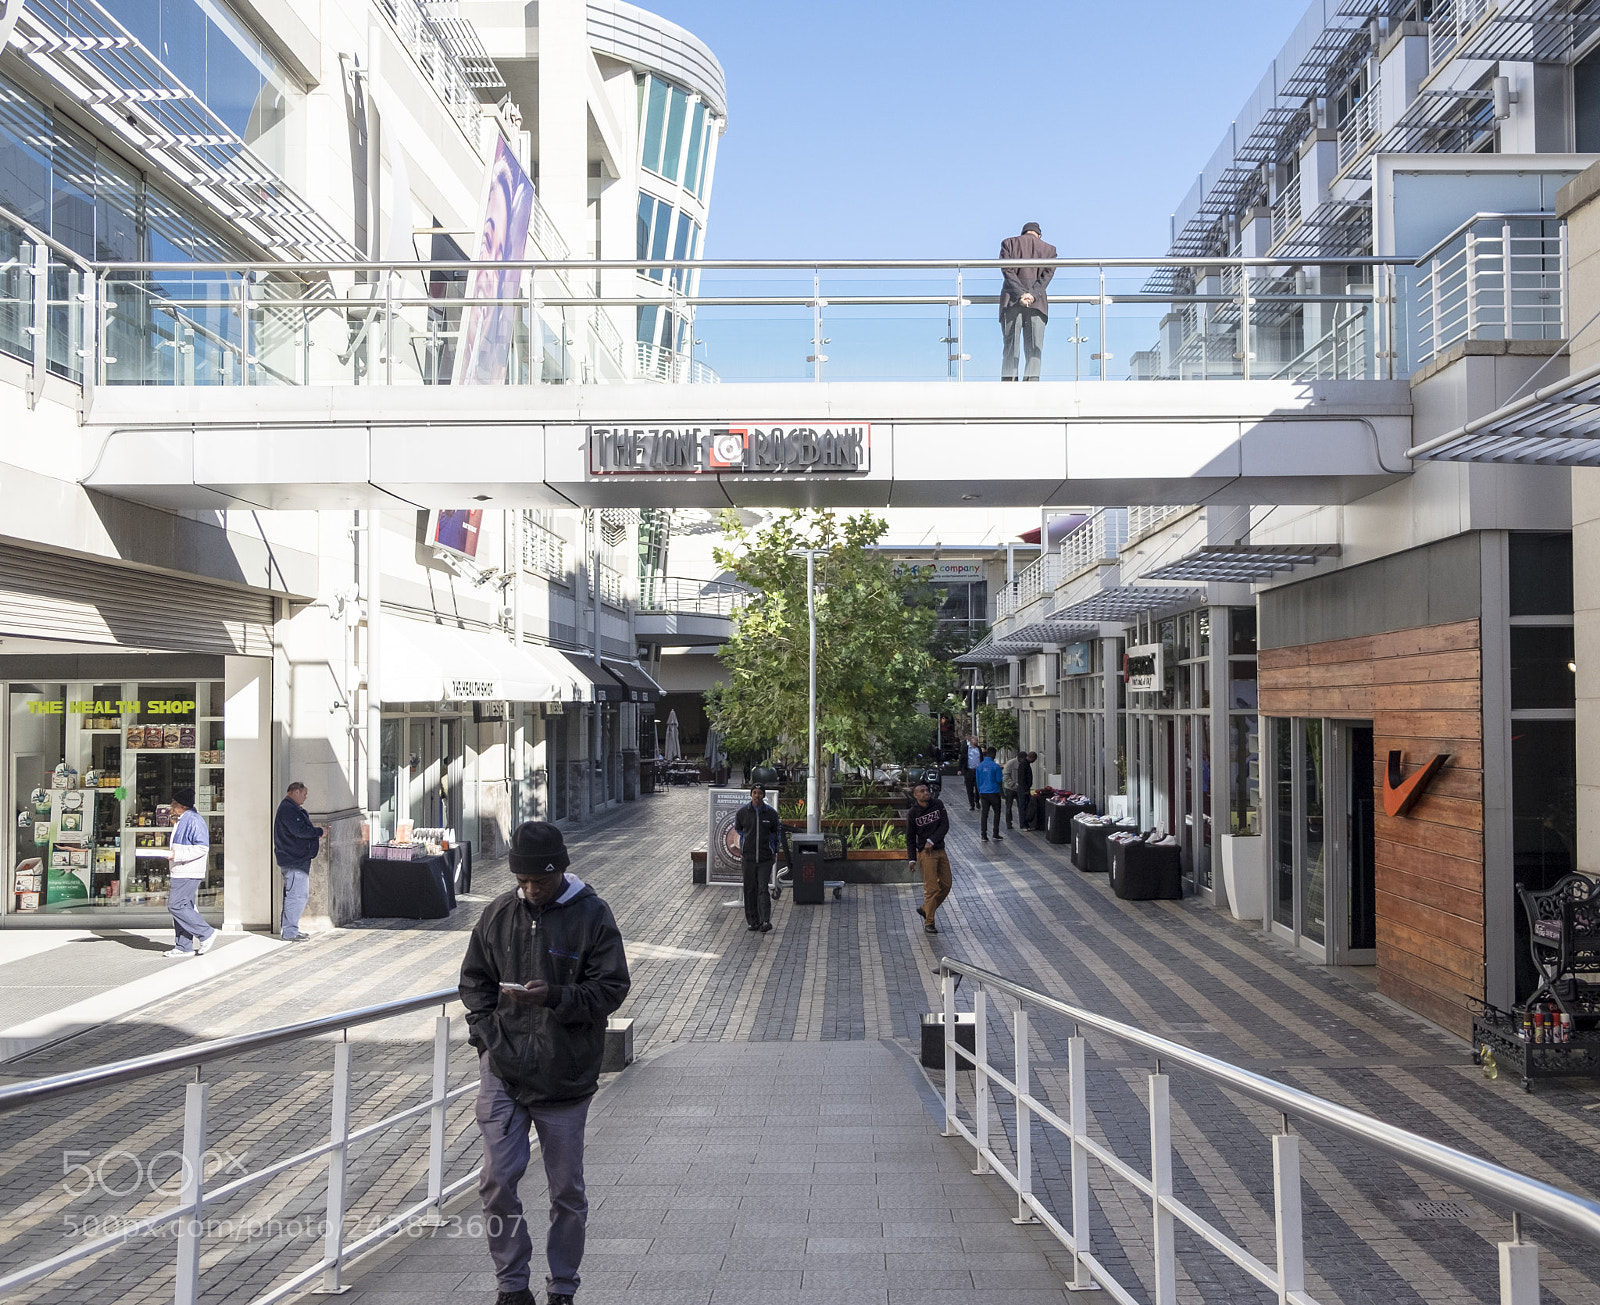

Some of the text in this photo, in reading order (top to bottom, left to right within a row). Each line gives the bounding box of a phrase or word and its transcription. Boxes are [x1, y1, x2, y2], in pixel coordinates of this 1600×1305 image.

[755, 427, 863, 466] ROSEBANK
[940, 565, 980, 574] company
[27, 701, 195, 714] THE HEALTH SHOP
[485, 702, 504, 717] DIESE
